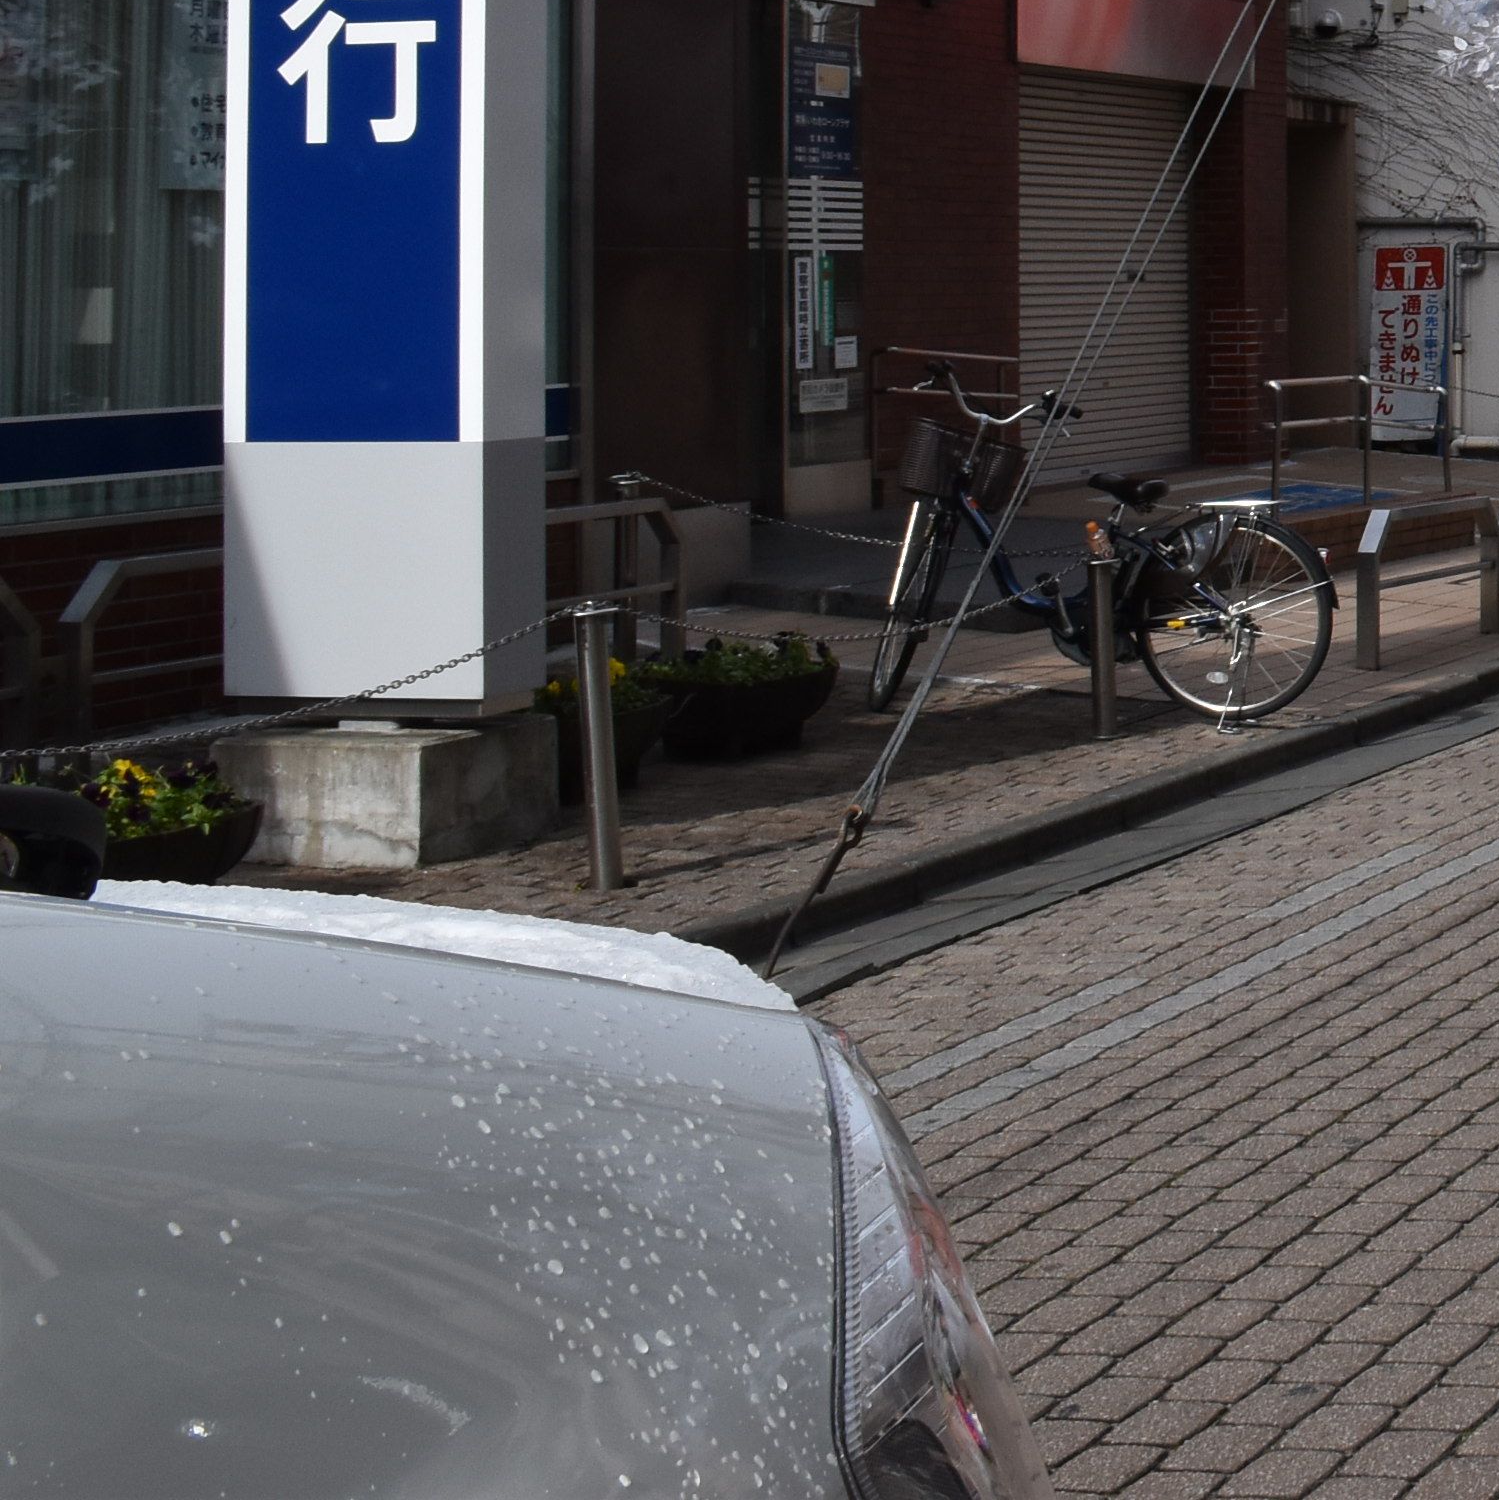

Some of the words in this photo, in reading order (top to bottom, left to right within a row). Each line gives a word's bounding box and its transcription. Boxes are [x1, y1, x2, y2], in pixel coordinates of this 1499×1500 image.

[1373, 307, 1400, 416] できません
[1400, 294, 1422, 386] 通りぬけ
